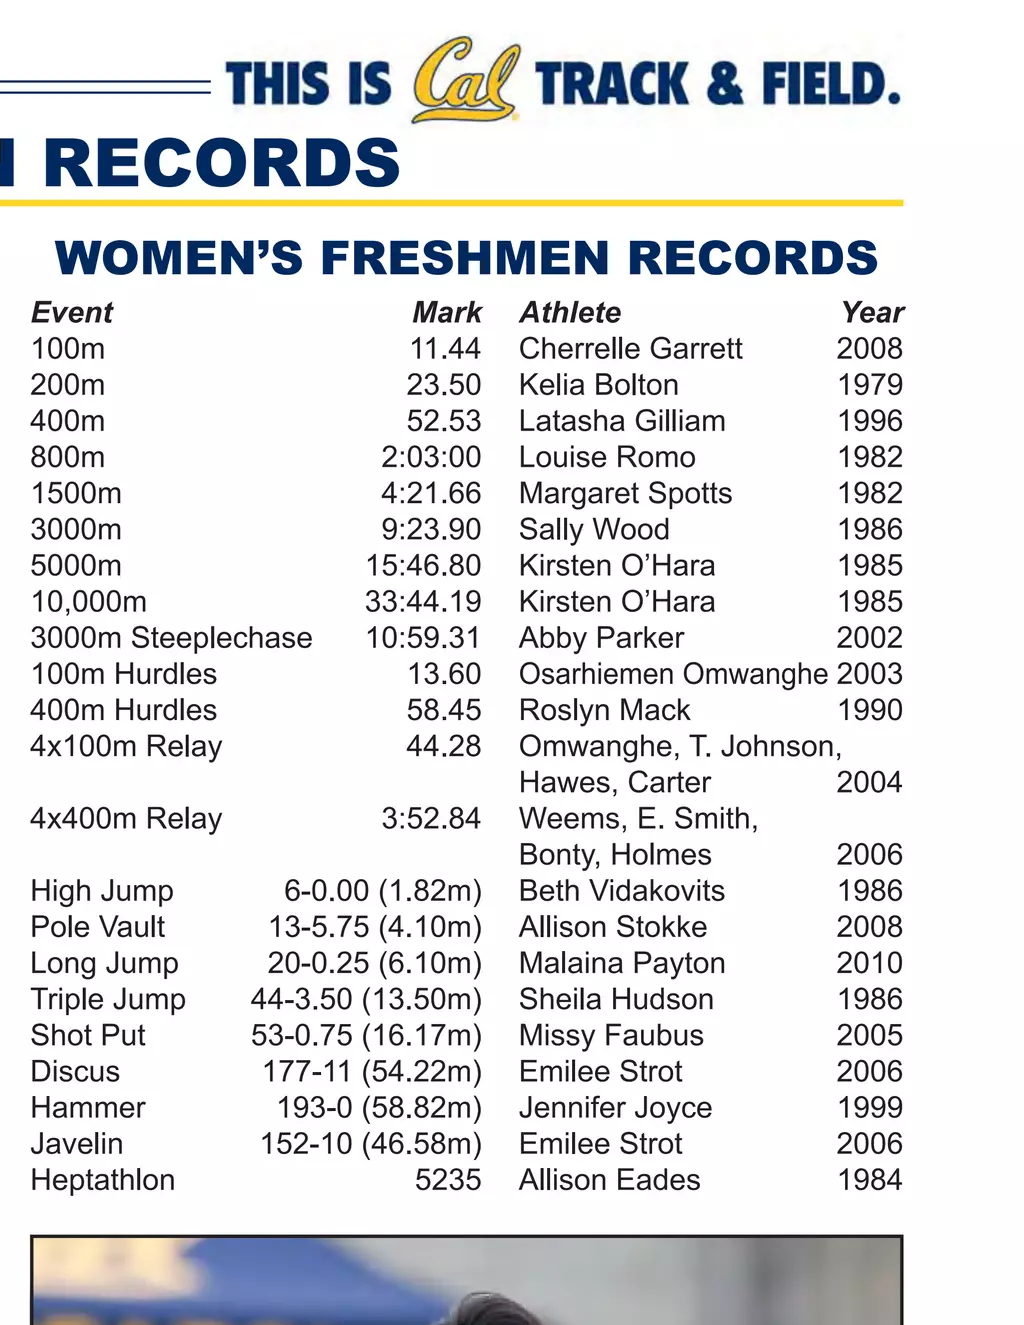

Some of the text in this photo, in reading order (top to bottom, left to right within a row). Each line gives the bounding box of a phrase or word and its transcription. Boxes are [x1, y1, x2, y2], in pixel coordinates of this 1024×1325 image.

[226, 36, 900, 124] THIS IS Cal TRACK & FIELD.
[46, 137, 399, 187] RECORDS
[55, 240, 877, 275] WOMEN’S FRESHMEN RECORDS
[31, 301, 906, 323] Event Mark Athlete Year
[30, 409, 902, 431] 400m 52.53 Latasha Gilliam 1996
[33, 590, 902, 616] 10,000m 33:44.19 Kirsten O’Hara 1985
[33, 662, 902, 690] 100m Hurdles 13.60 Osarhiemen Omwanghe 2003
[32, 951, 902, 980] Long Jump 20-0.25 (6.10m) Malaina Payton 2010
[32, 1059, 902, 1088] Discus 177-11 (54.22m) Emilee Strot 2006
[32, 1168, 902, 1196] Heptathlon 5235 Allison Eades 1984
